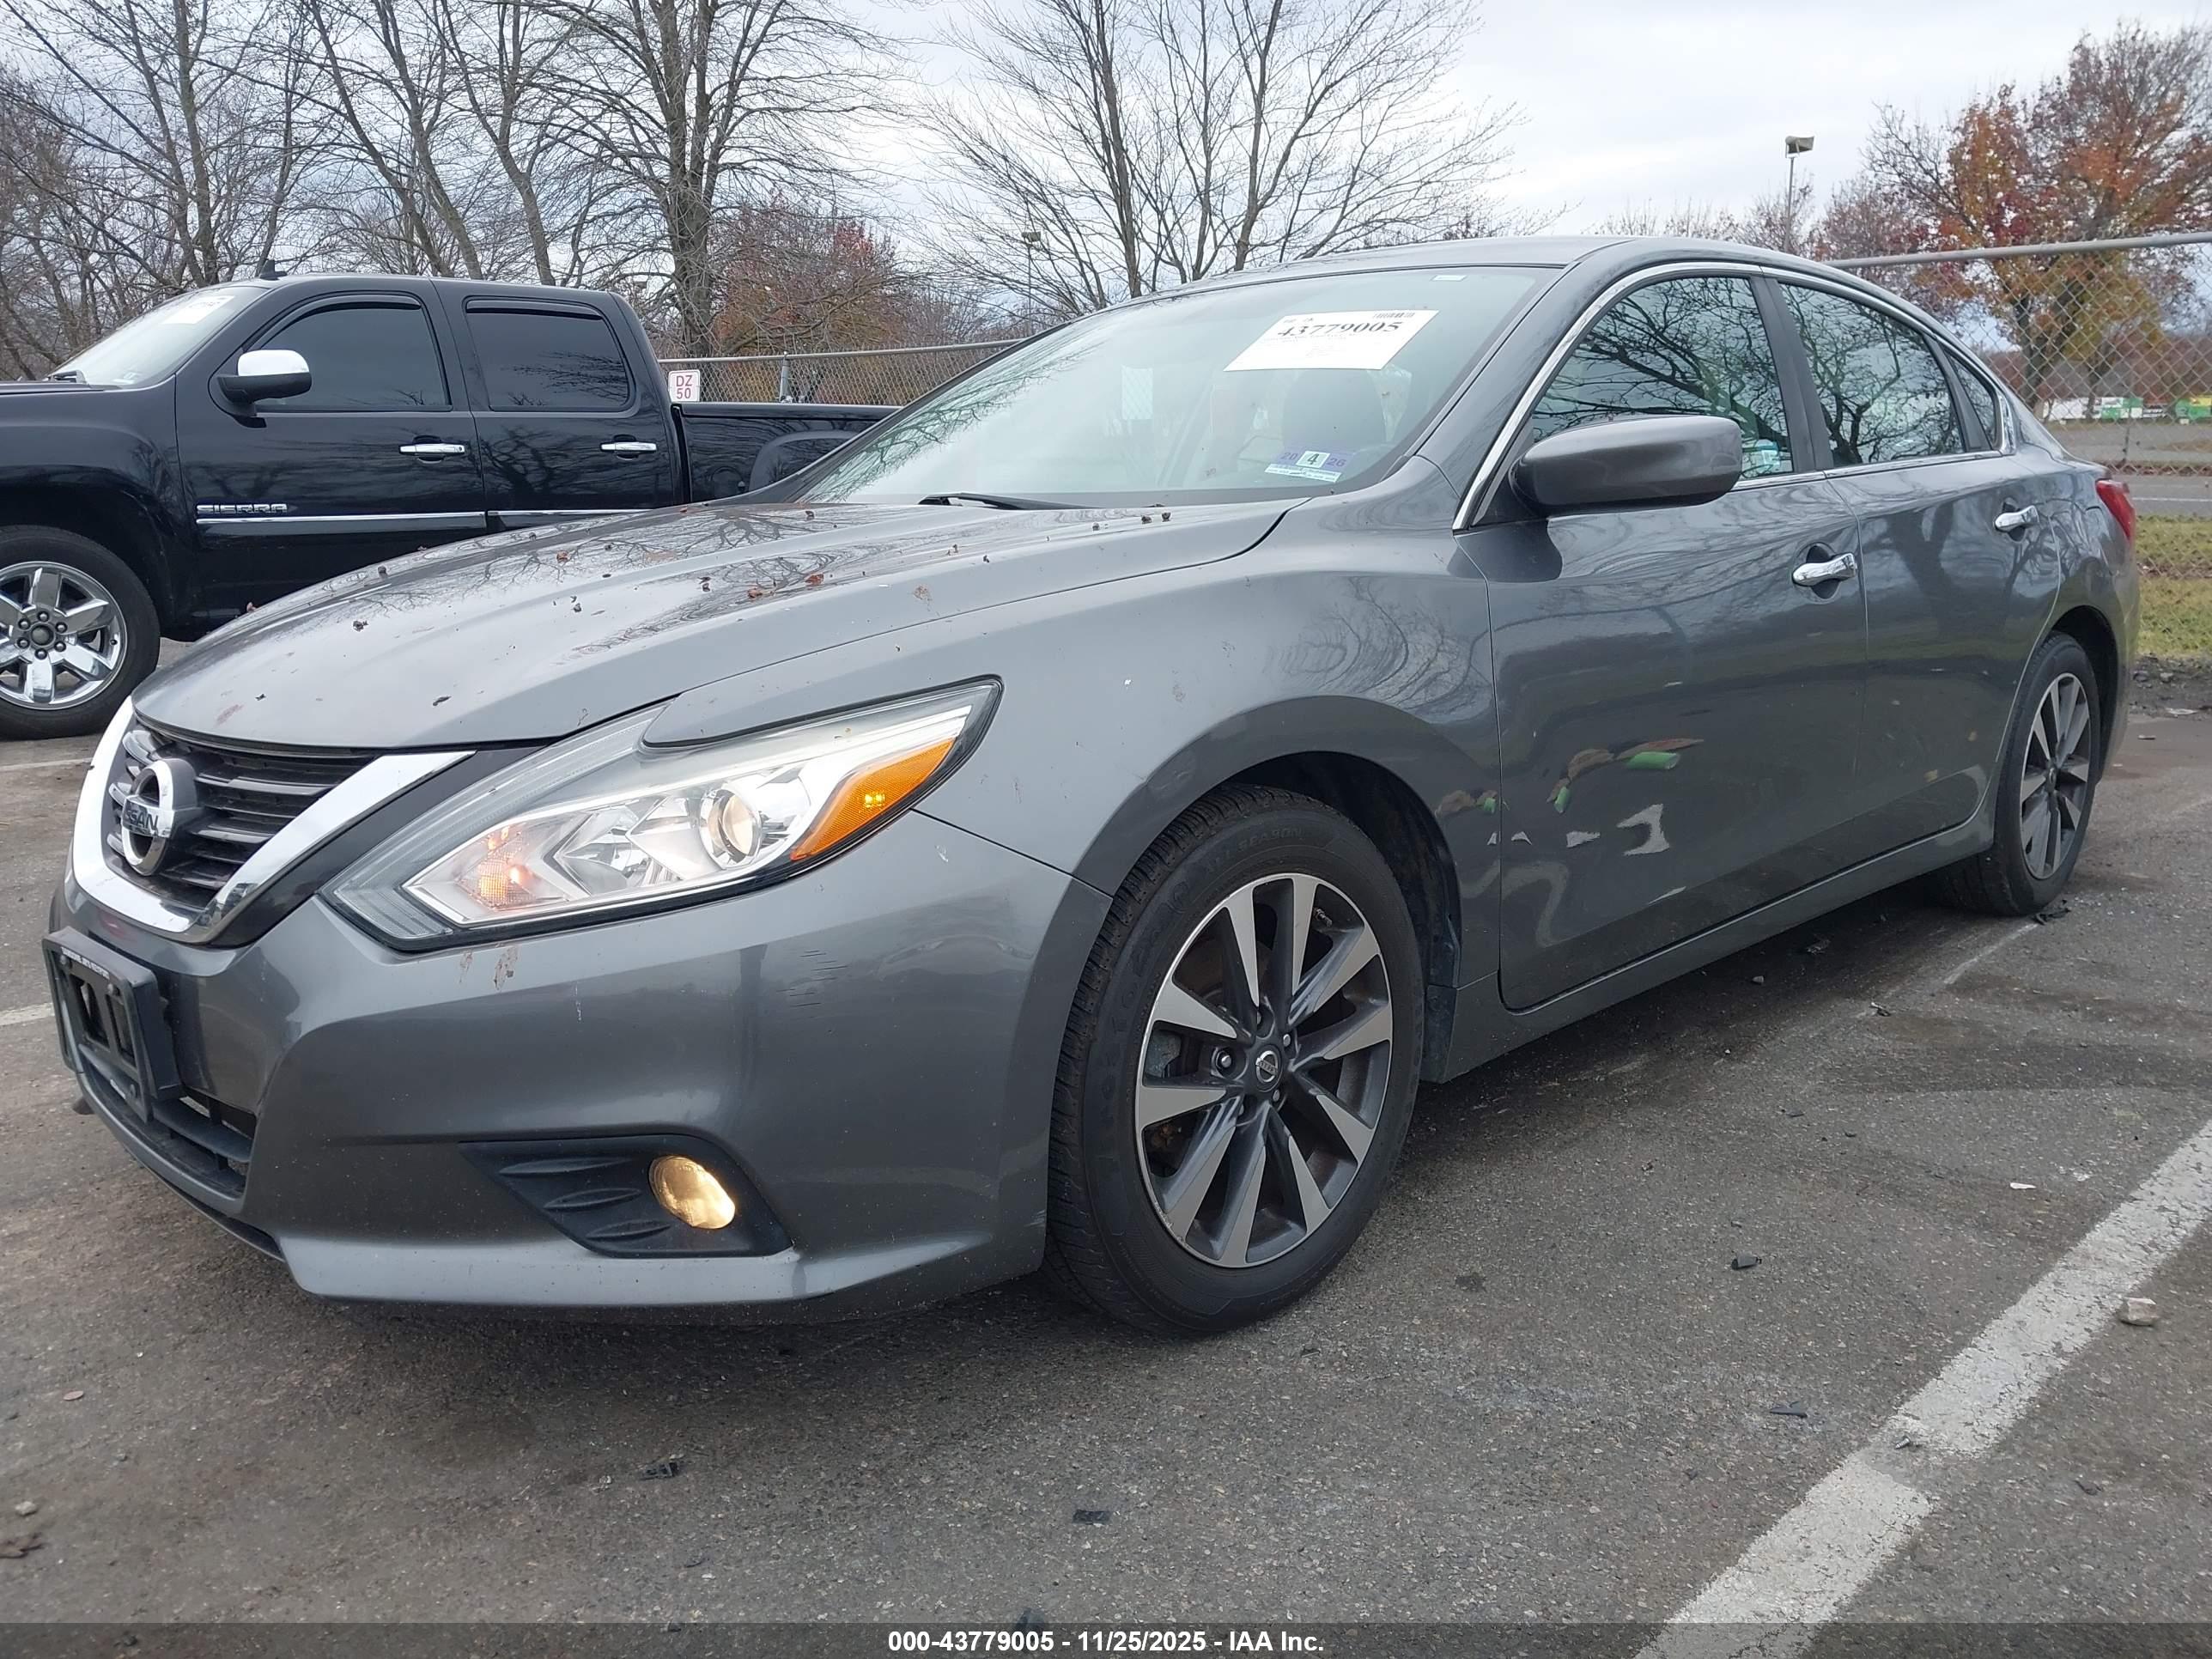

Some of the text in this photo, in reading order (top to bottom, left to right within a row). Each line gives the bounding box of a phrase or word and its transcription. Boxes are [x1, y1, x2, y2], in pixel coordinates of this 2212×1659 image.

[1278, 321, 1405, 337] 43779005
[676, 375, 692, 386] DZ
[676, 387, 691, 399] 50
[1280, 452, 1346, 467] 20 4 26
[197, 503, 288, 514] SIERRA
